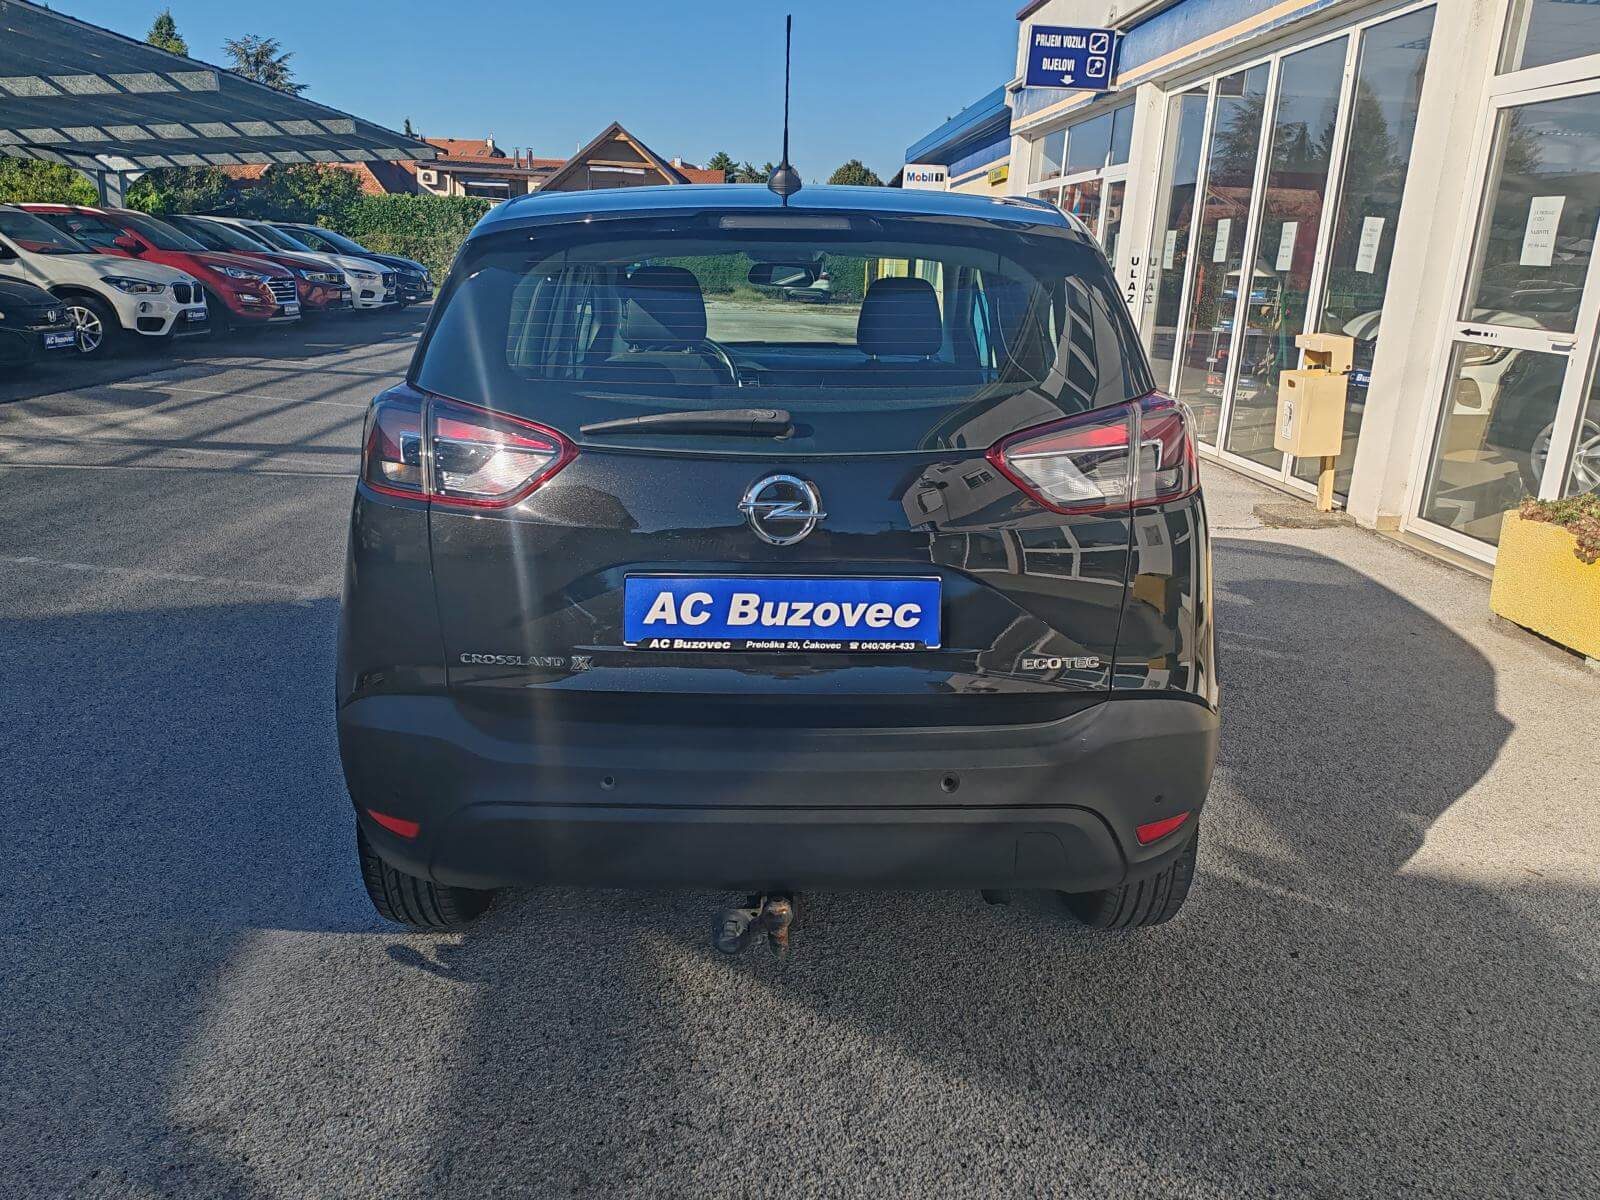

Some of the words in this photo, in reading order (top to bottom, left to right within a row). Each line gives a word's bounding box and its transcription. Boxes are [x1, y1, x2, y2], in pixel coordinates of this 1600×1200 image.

[1035, 33, 1062, 47] PRIJEM
[1063, 35, 1087, 49] VOZILA
[1042, 57, 1076, 72] DIJELOVI
[906, 172, 934, 182] Mobil
[1126, 256, 1140, 304] ULAZ
[46, 336, 55, 345] AC
[643, 591, 714, 626] AC
[727, 593, 922, 629] Buzovec
[650, 639, 670, 649] AC
[673, 639, 731, 650] Buzovec
[746, 640, 785, 650] Preloška
[786, 641, 801, 651] 20,
[803, 639, 842, 650] Čakovec
[861, 641, 916, 651] 040/364-433
[460, 652, 566, 667] CROSSLAND
[570, 655, 593, 672] X
[1021, 656, 1100, 670] ECOTEC
